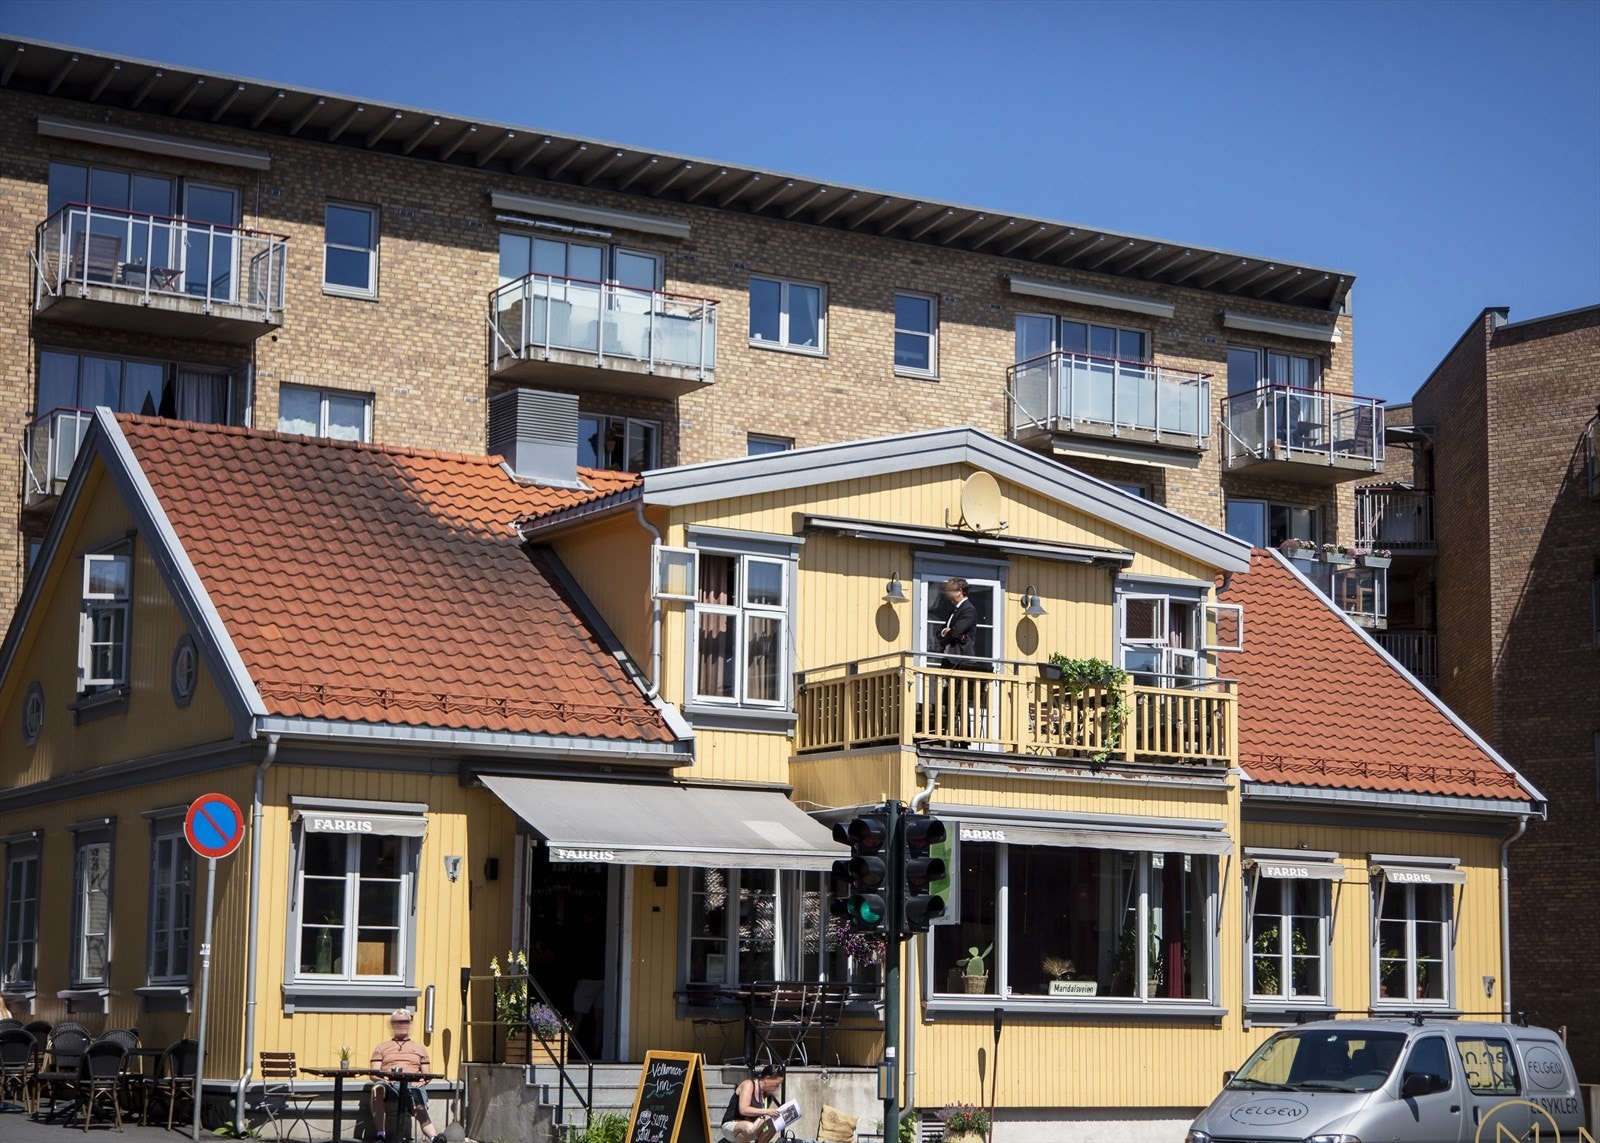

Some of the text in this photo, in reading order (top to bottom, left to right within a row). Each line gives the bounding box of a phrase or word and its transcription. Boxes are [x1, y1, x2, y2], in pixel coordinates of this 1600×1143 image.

[314, 819, 372, 832] FARRIS
[558, 849, 615, 860] FARRIS
[1267, 867, 1309, 877] FARRIS
[1392, 873, 1432, 882] FARRIS
[1054, 984, 1094, 993] Maridalsveien
[1528, 1061, 1562, 1074] FELGEN
[1235, 1106, 1302, 1117] FELGEN
[1530, 1098, 1578, 1115] ELSYKLER
